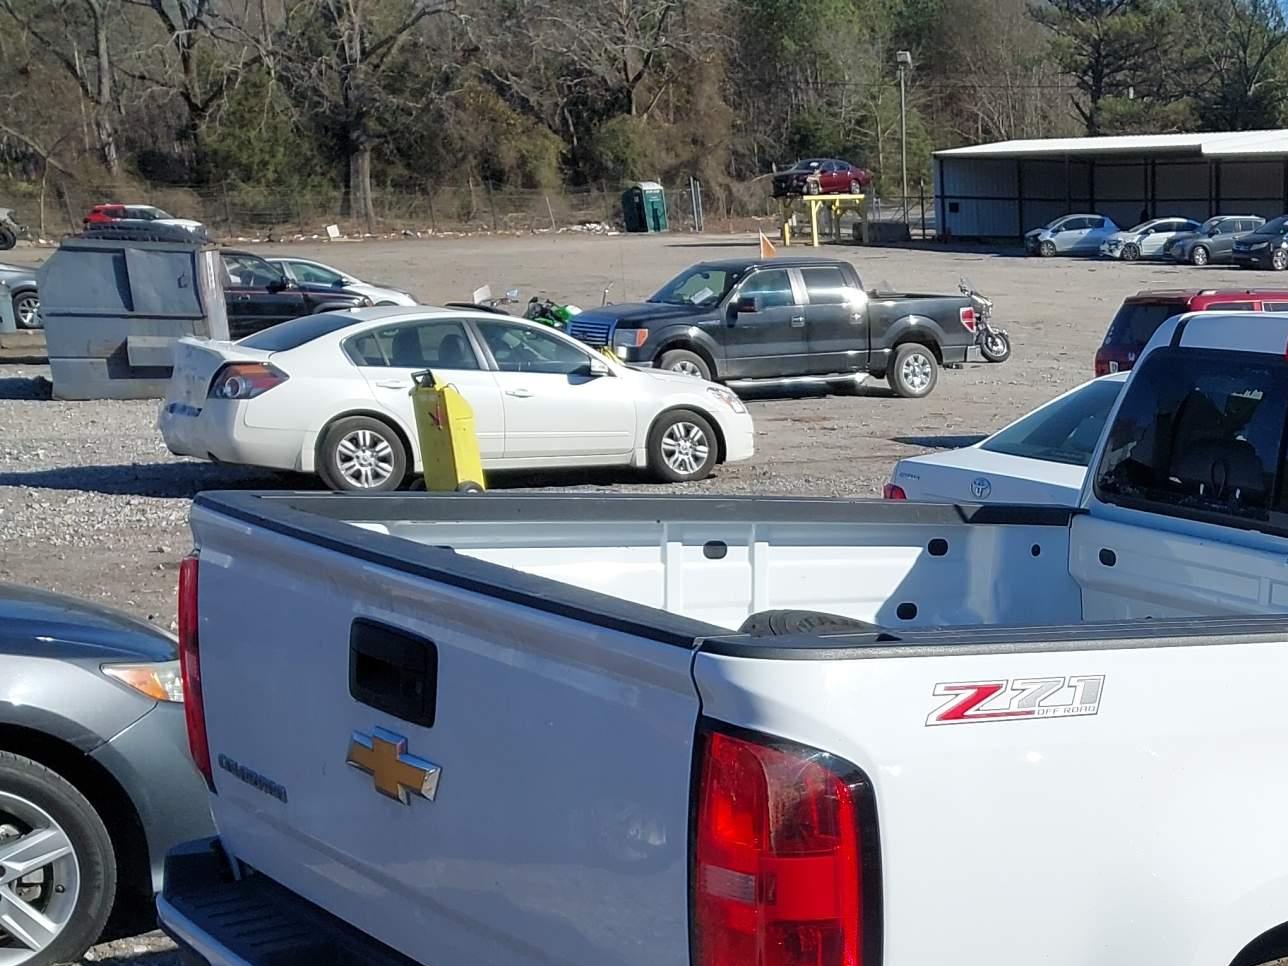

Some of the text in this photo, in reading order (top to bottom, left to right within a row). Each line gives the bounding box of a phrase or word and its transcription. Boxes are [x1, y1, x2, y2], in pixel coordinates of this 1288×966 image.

[925, 675, 1106, 727] Z71
[1037, 704, 1097, 716] OFF ROAD
